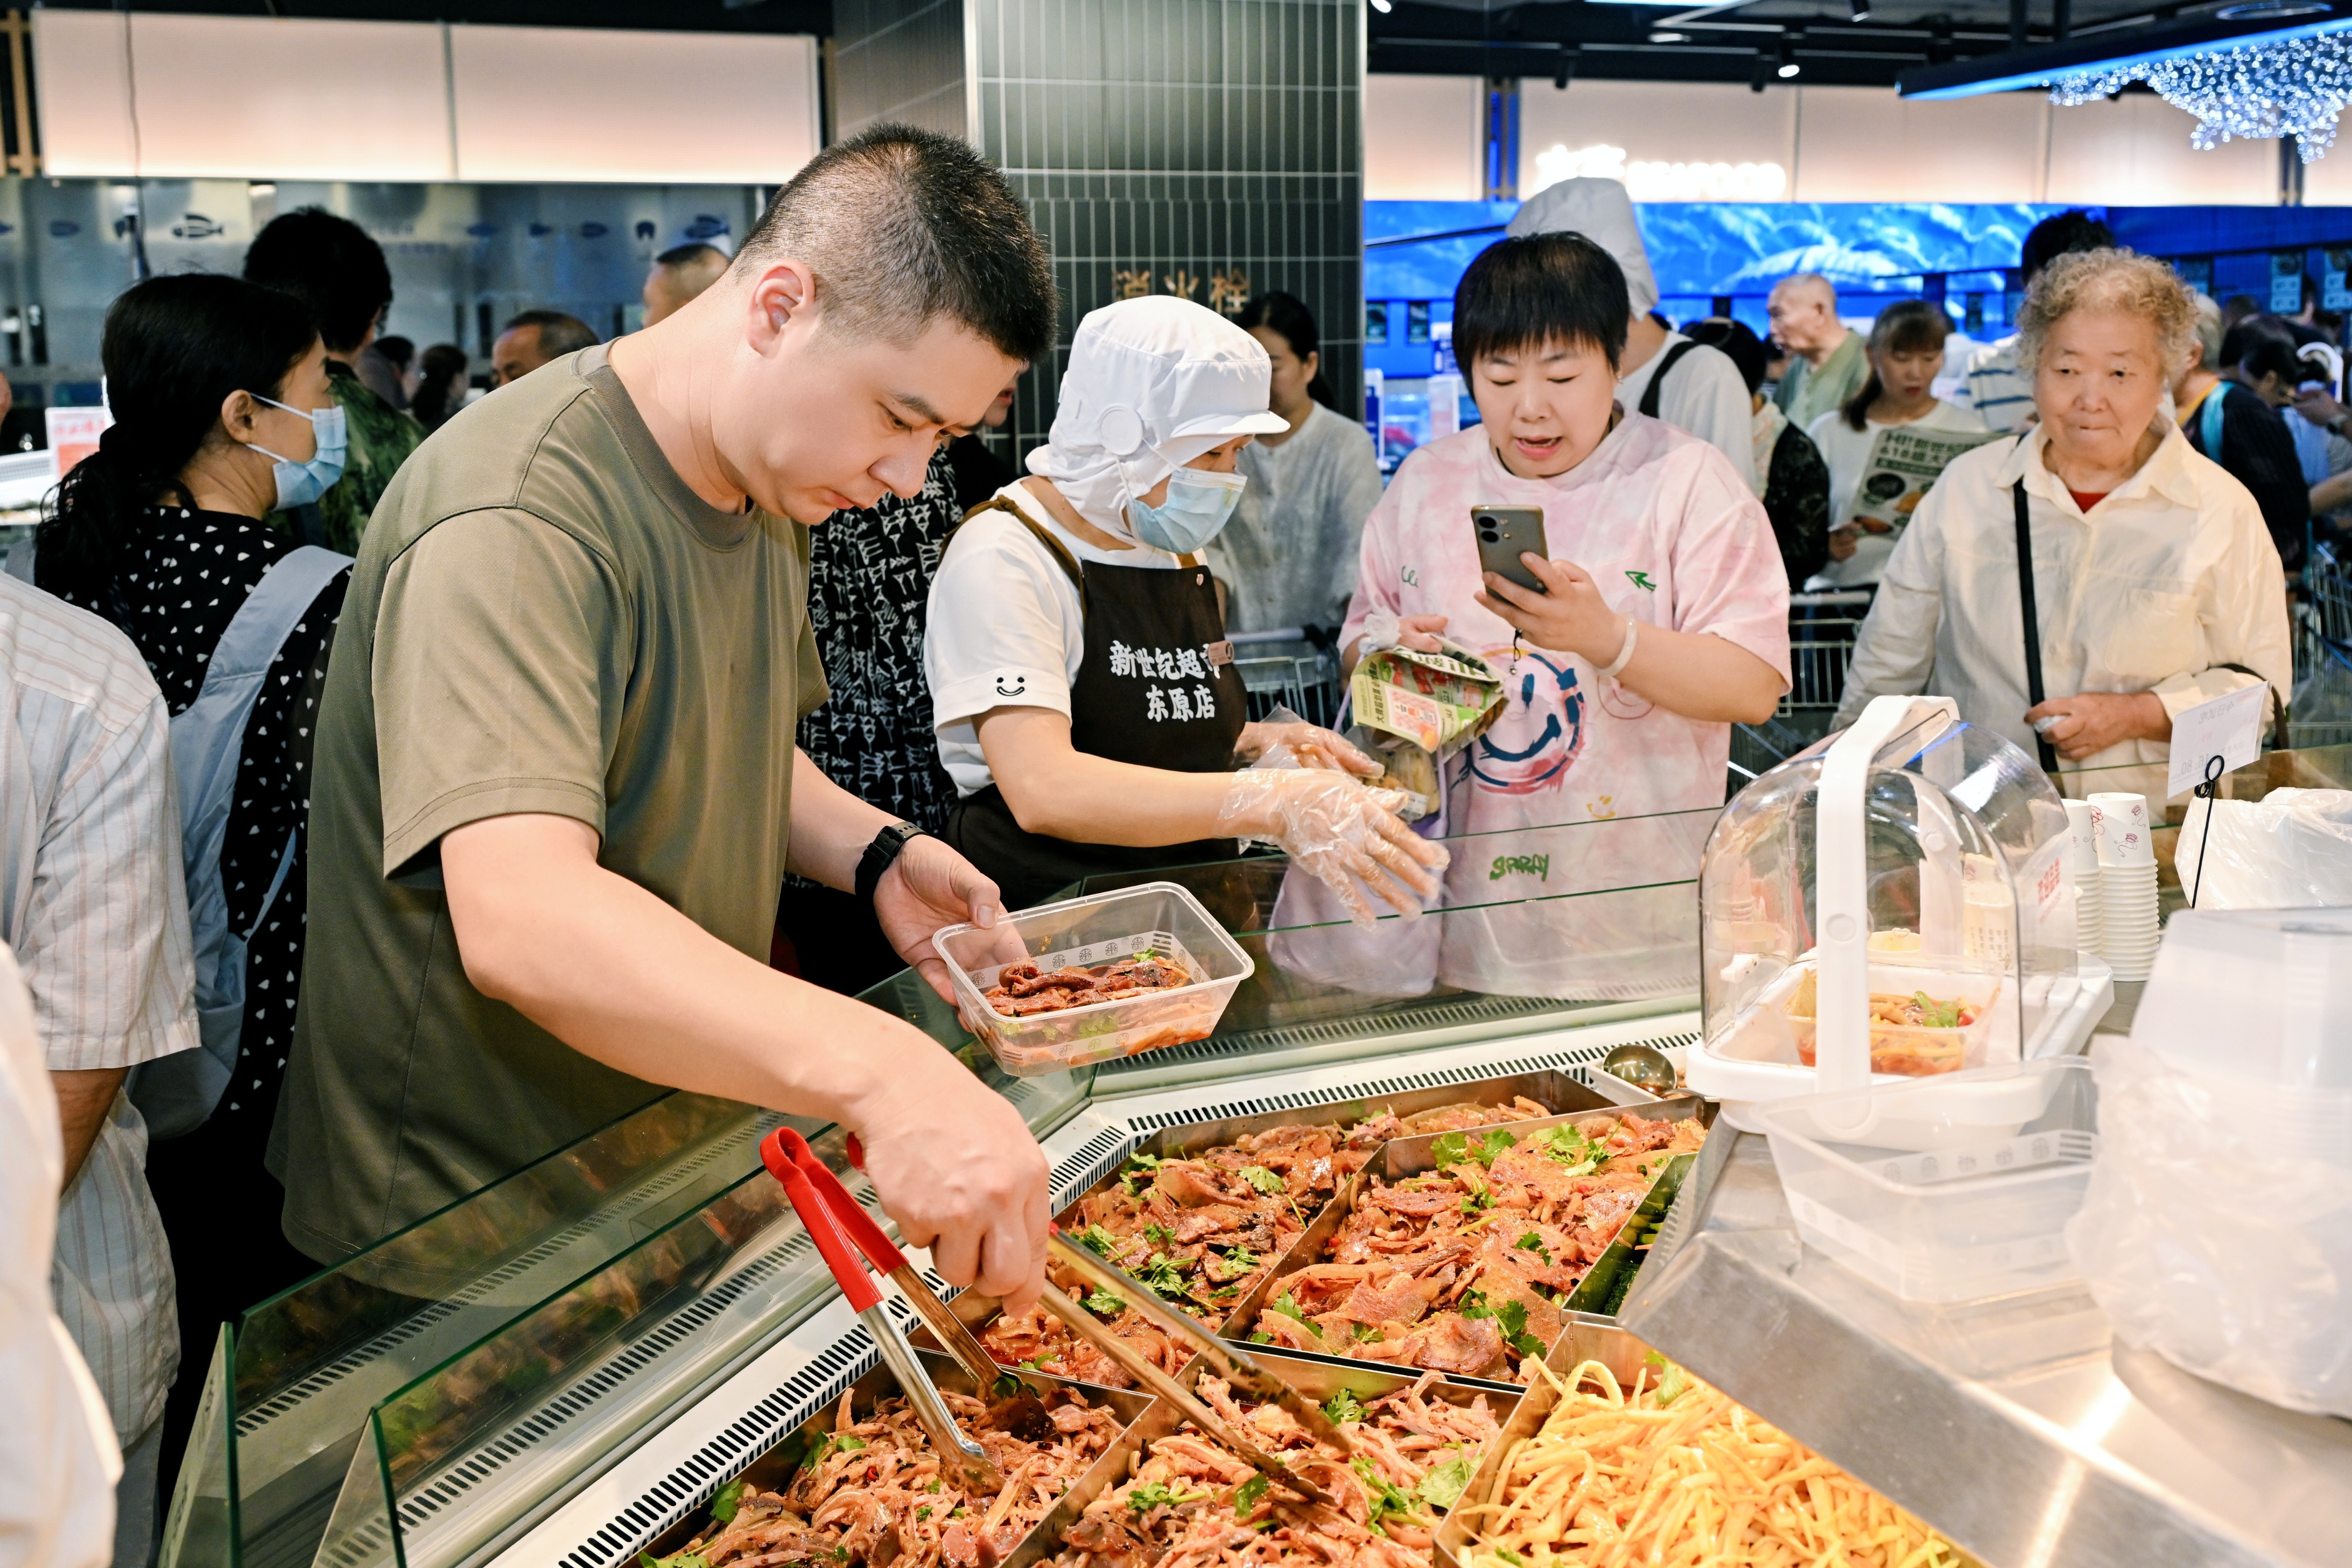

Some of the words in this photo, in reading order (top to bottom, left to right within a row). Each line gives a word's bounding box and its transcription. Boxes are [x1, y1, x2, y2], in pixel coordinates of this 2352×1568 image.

[1113, 269, 1250, 314] 消火栓
[1146, 684, 1215, 722] 东原店
